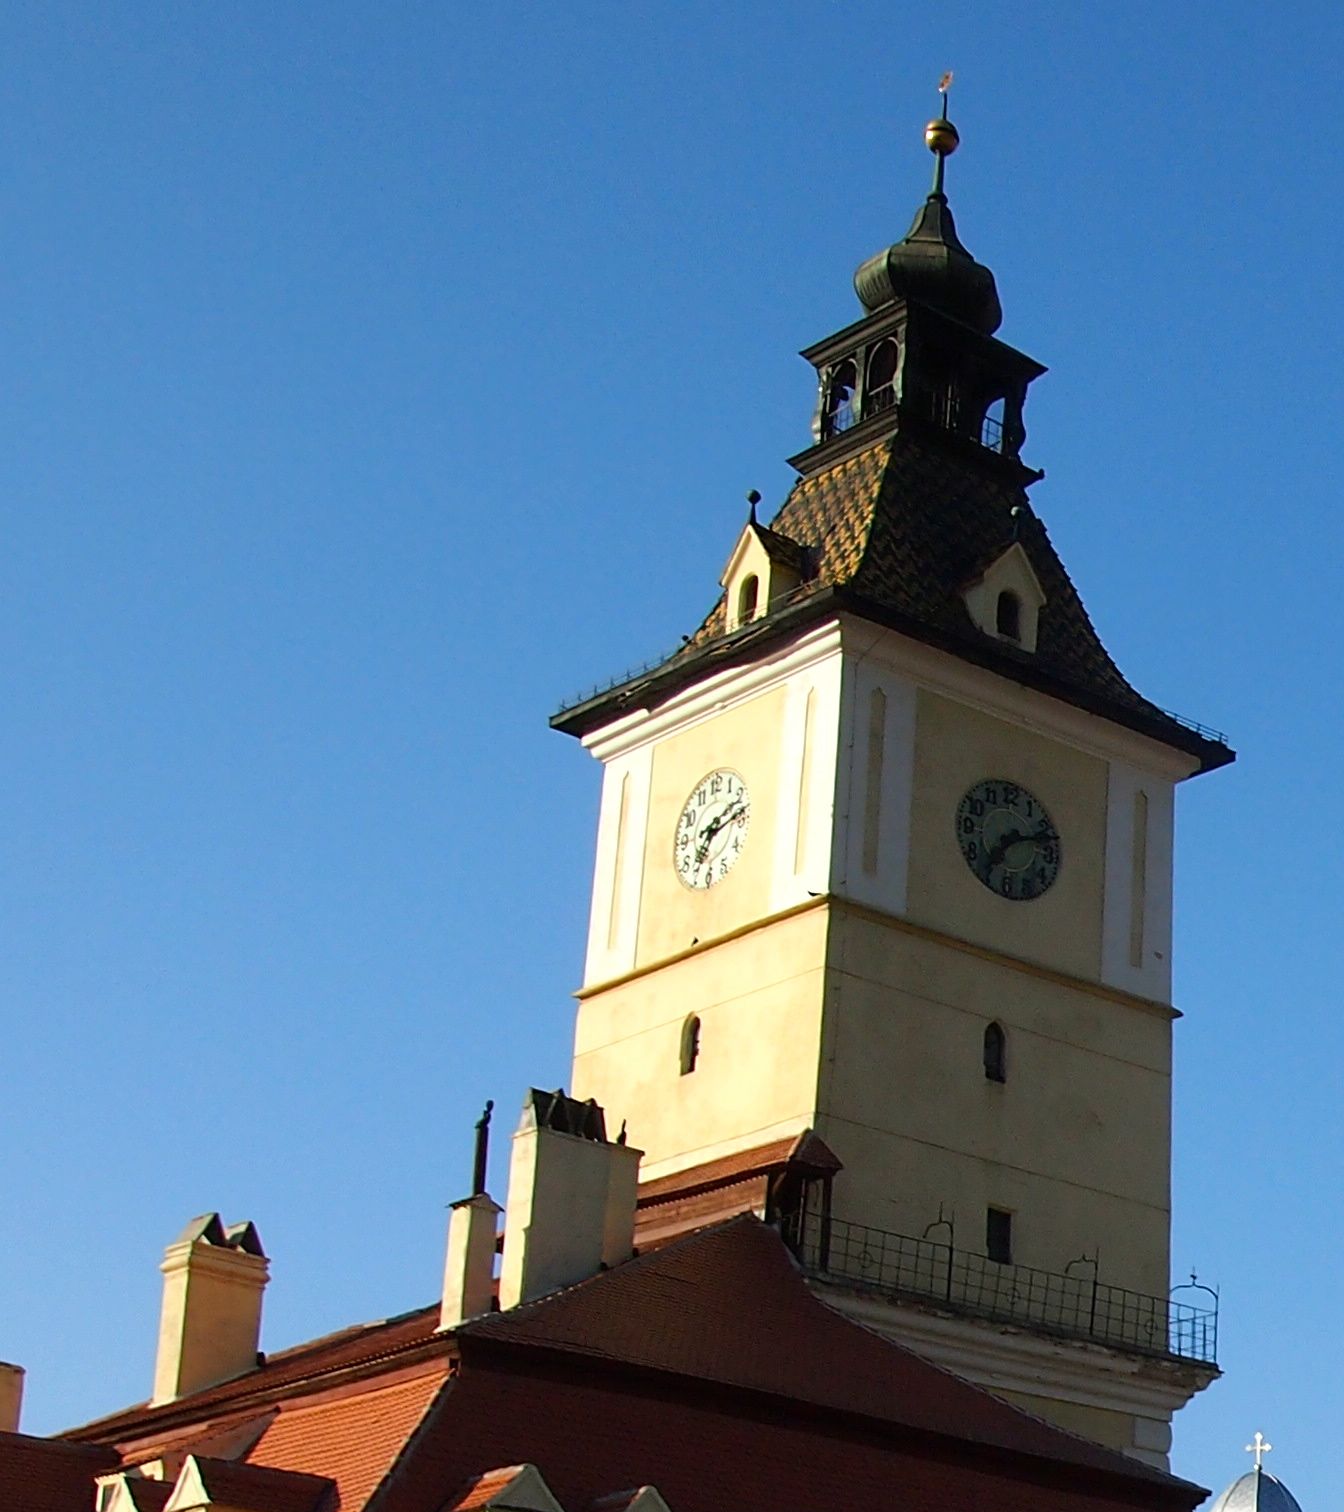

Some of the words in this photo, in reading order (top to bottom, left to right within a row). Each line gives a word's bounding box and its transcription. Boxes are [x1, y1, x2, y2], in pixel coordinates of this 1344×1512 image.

[710, 772, 723, 796] 12
[698, 789, 706, 807] 11
[683, 809, 696, 829] 10
[680, 833, 689, 851] 9
[680, 855, 690, 874] 8
[719, 856, 729, 875] 5
